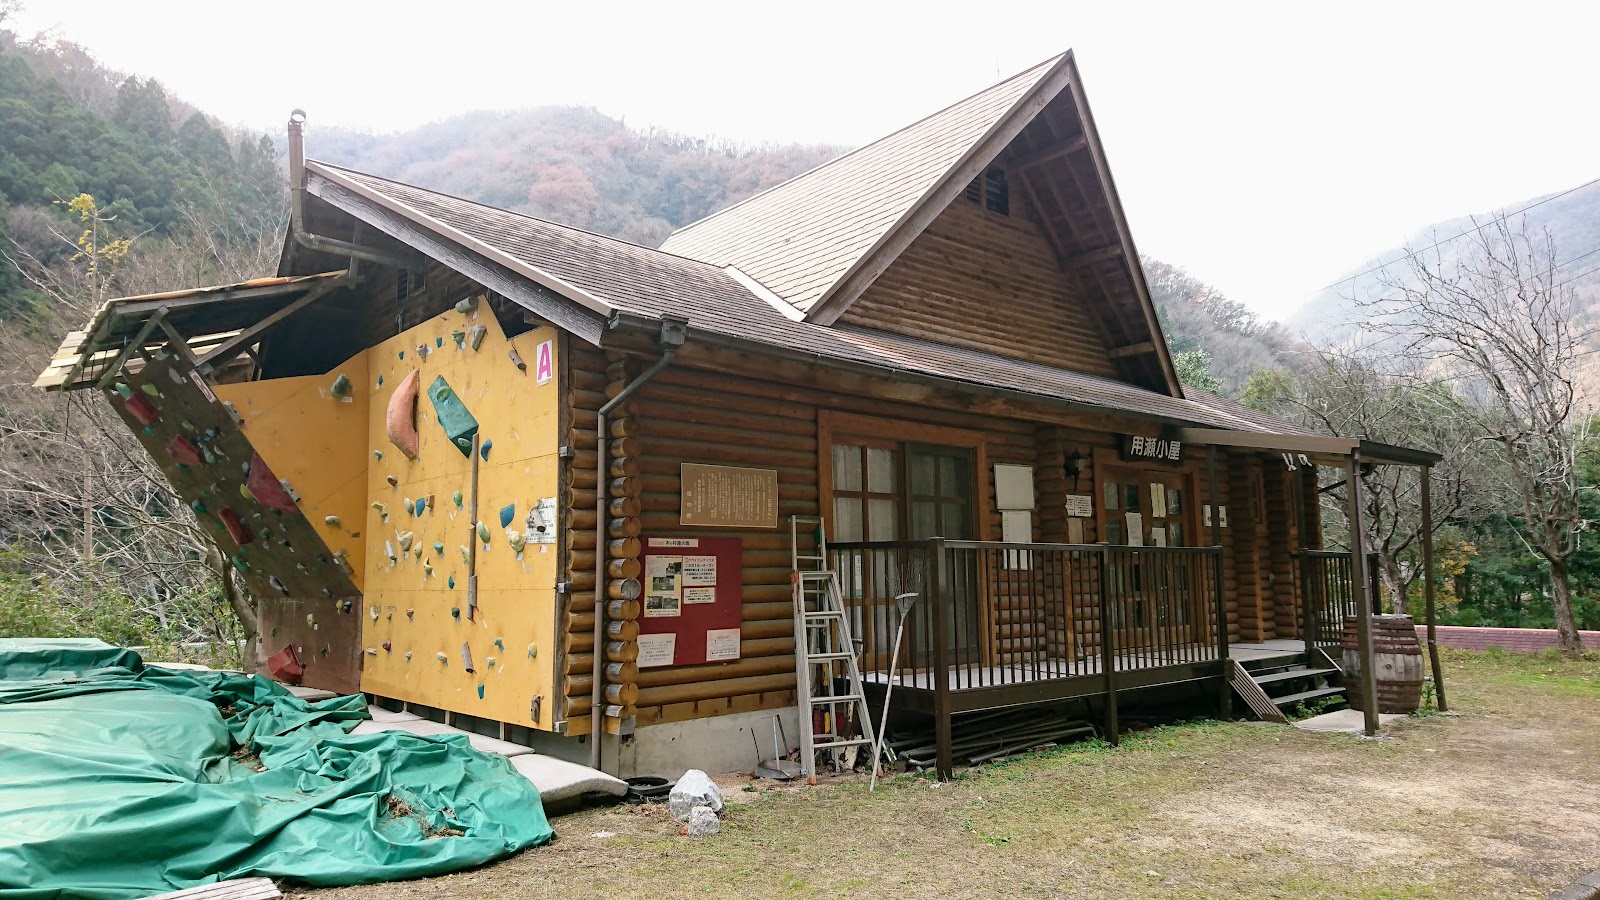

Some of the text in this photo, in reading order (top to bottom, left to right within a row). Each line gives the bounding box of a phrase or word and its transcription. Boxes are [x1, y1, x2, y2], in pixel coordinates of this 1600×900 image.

[538, 343, 551, 380] A
[1131, 436, 1181, 460] 用瀬小屋
